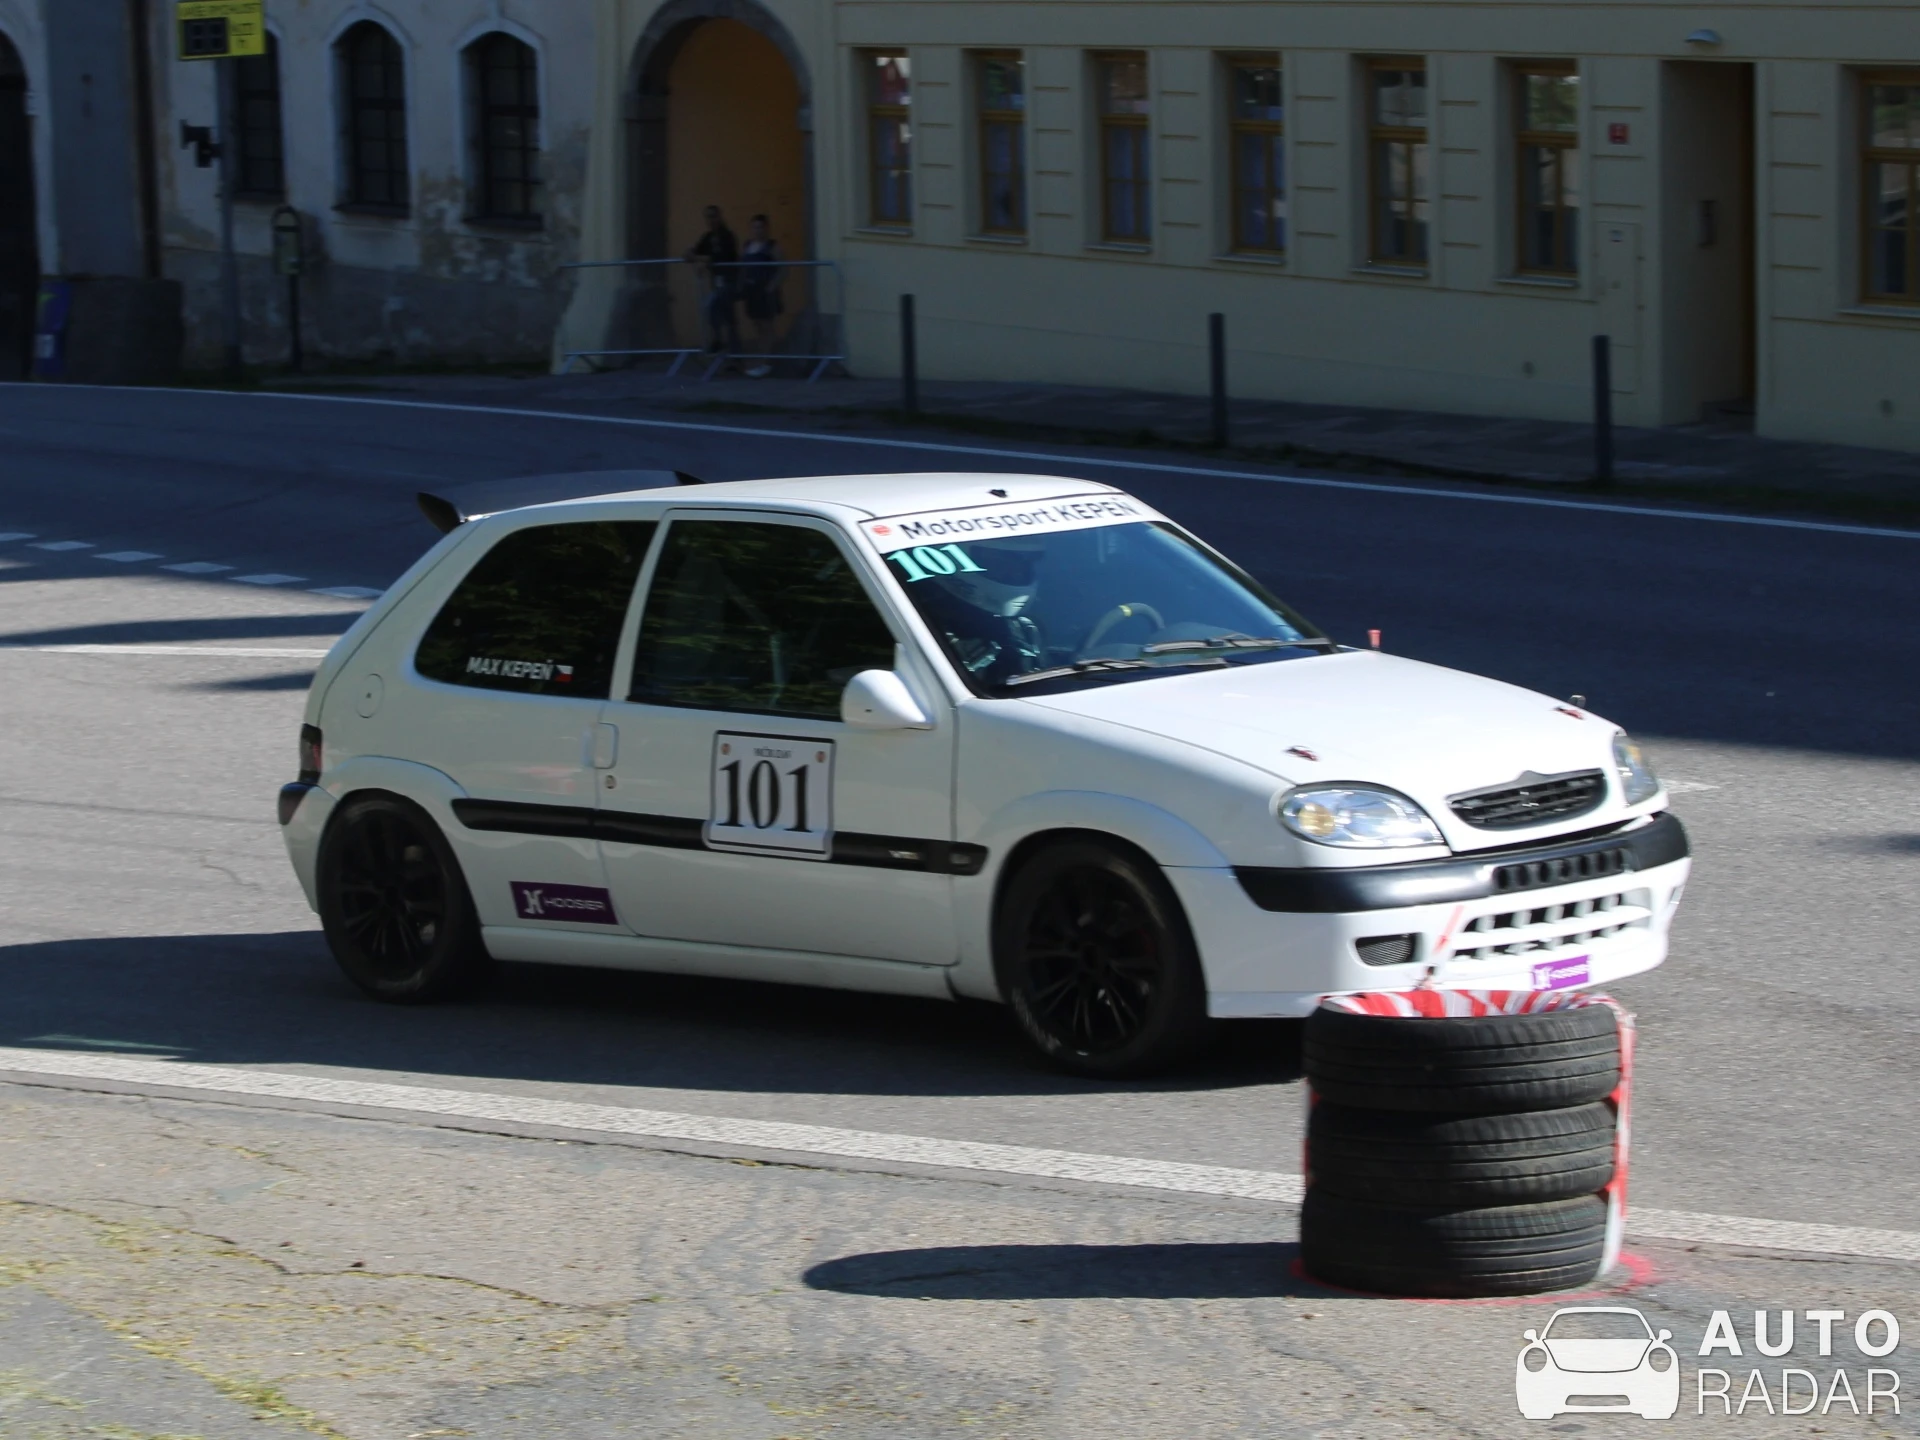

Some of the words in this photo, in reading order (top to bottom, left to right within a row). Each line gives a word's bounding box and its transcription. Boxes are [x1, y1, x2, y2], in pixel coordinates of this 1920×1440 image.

[897, 507, 1058, 540] Motorsport
[887, 544, 987, 582] 101
[466, 656, 502, 676] MAX
[716, 759, 814, 833] 101
